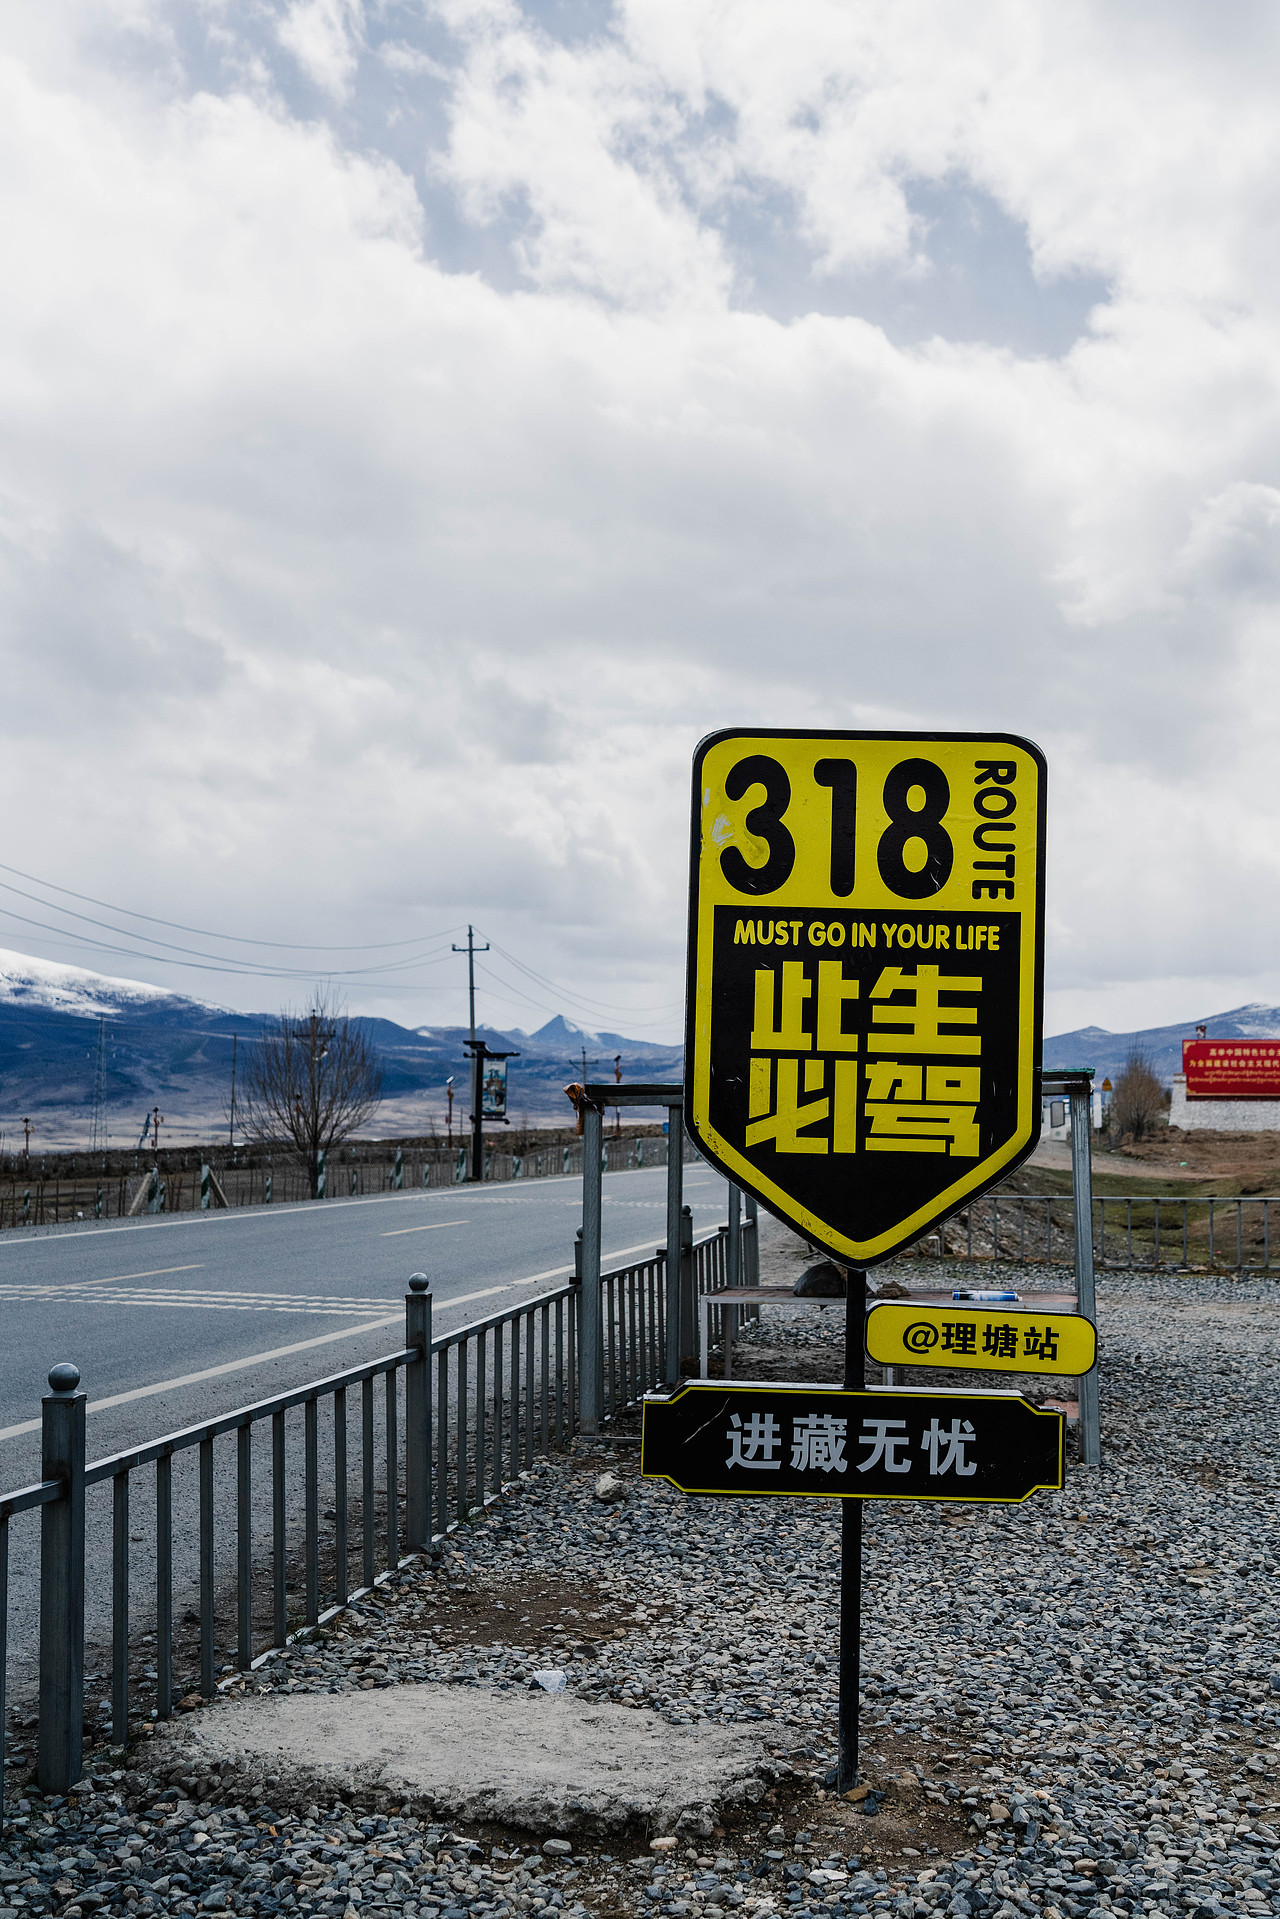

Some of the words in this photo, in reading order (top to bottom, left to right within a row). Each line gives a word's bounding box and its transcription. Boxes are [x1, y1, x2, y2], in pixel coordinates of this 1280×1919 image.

[720, 755, 953, 899] 318
[972, 760, 1016, 901] ROUTE
[733, 919, 804, 946] MUST
[808, 921, 846, 947] GO
[851, 922, 877, 948] IN
[882, 923, 950, 949] YOUR
[955, 925, 1000, 951] LIFE
[750, 960, 983, 1055] 此生
[745, 1058, 981, 1157] 必驾
[902, 1321, 1060, 1361] @理塘站
[725, 1413, 978, 1476] 进藏无忧
